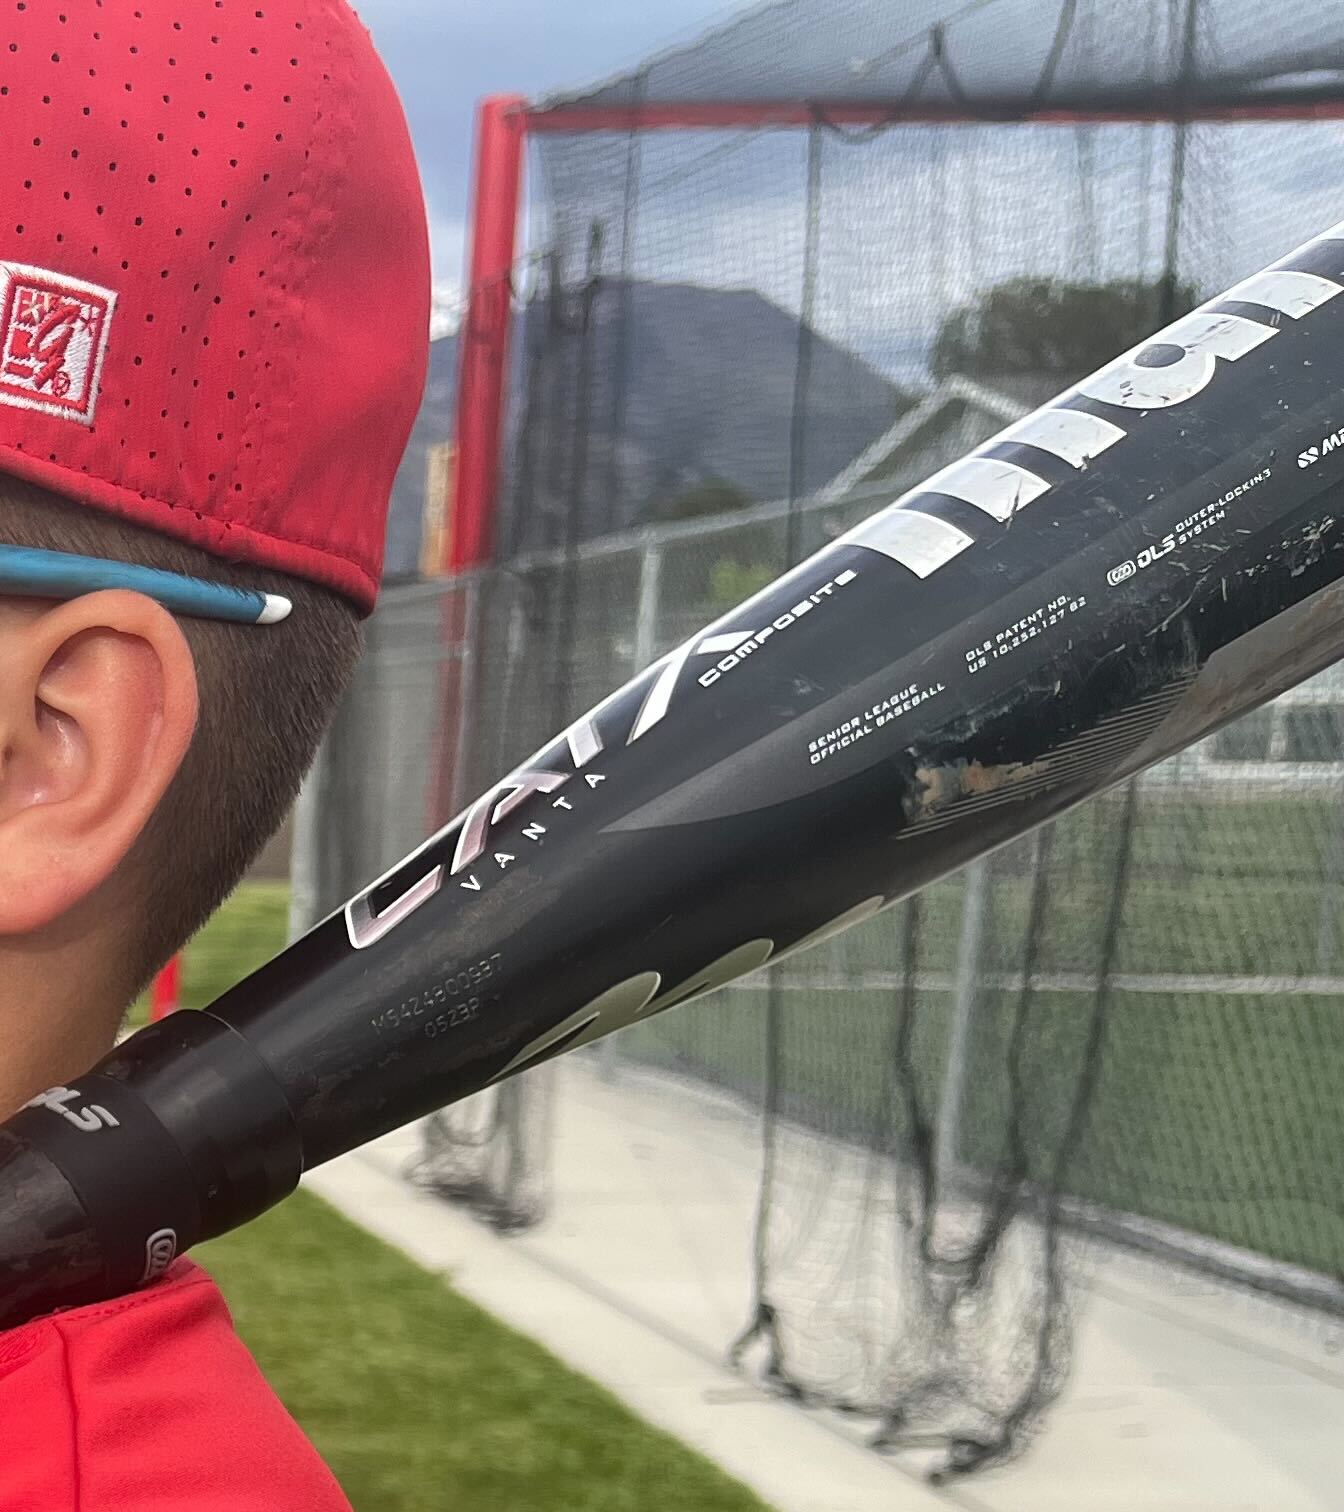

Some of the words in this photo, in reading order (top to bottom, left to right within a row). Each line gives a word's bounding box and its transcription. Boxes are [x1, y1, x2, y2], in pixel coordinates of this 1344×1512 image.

[1178, 510, 1226, 545] SYSTEM
[698, 569, 858, 688] COMPOSITE
[996, 608, 1043, 643] PATENT
[968, 657, 987, 674] US
[808, 716, 860, 752] SENIOR
[864, 683, 918, 720] LEAGUE
[810, 725, 873, 765] OFFICIAL
[875, 683, 946, 727] BASEBALL
[460, 772, 606, 891] VANTA
